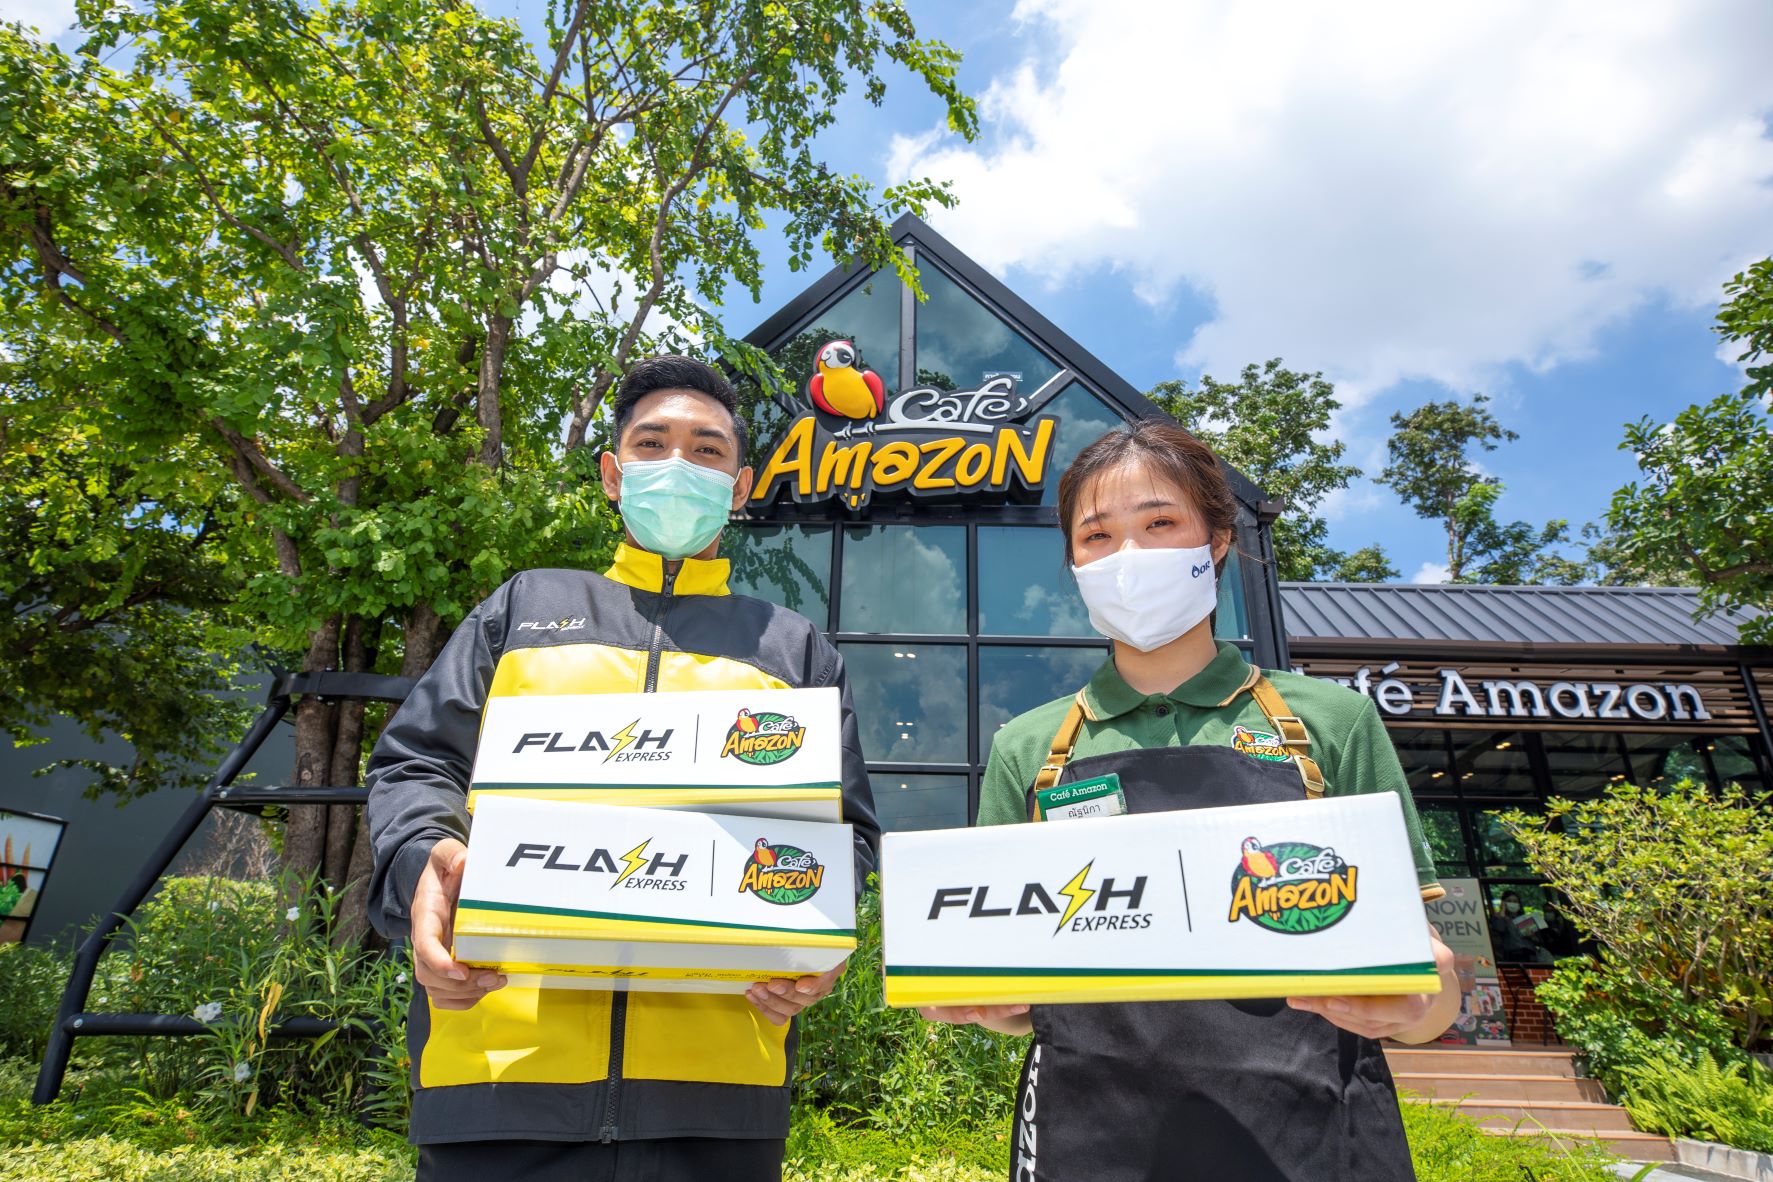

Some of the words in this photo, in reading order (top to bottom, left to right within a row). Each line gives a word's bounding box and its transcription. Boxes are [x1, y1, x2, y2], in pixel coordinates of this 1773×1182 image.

[517, 616, 586, 631] FLASH
[1435, 669, 1711, 720] Amazon
[512, 719, 674, 762] FLASH
[615, 751, 672, 762] EXPRESS
[1050, 790, 1071, 801] Café
[1072, 783, 1108, 797] Amazon
[505, 838, 689, 889] FLASH
[624, 877, 688, 891] EXPRESS
[927, 859, 1148, 935] FLASH
[1425, 900, 1477, 915] NOW
[1071, 913, 1152, 932] EXPRESS
